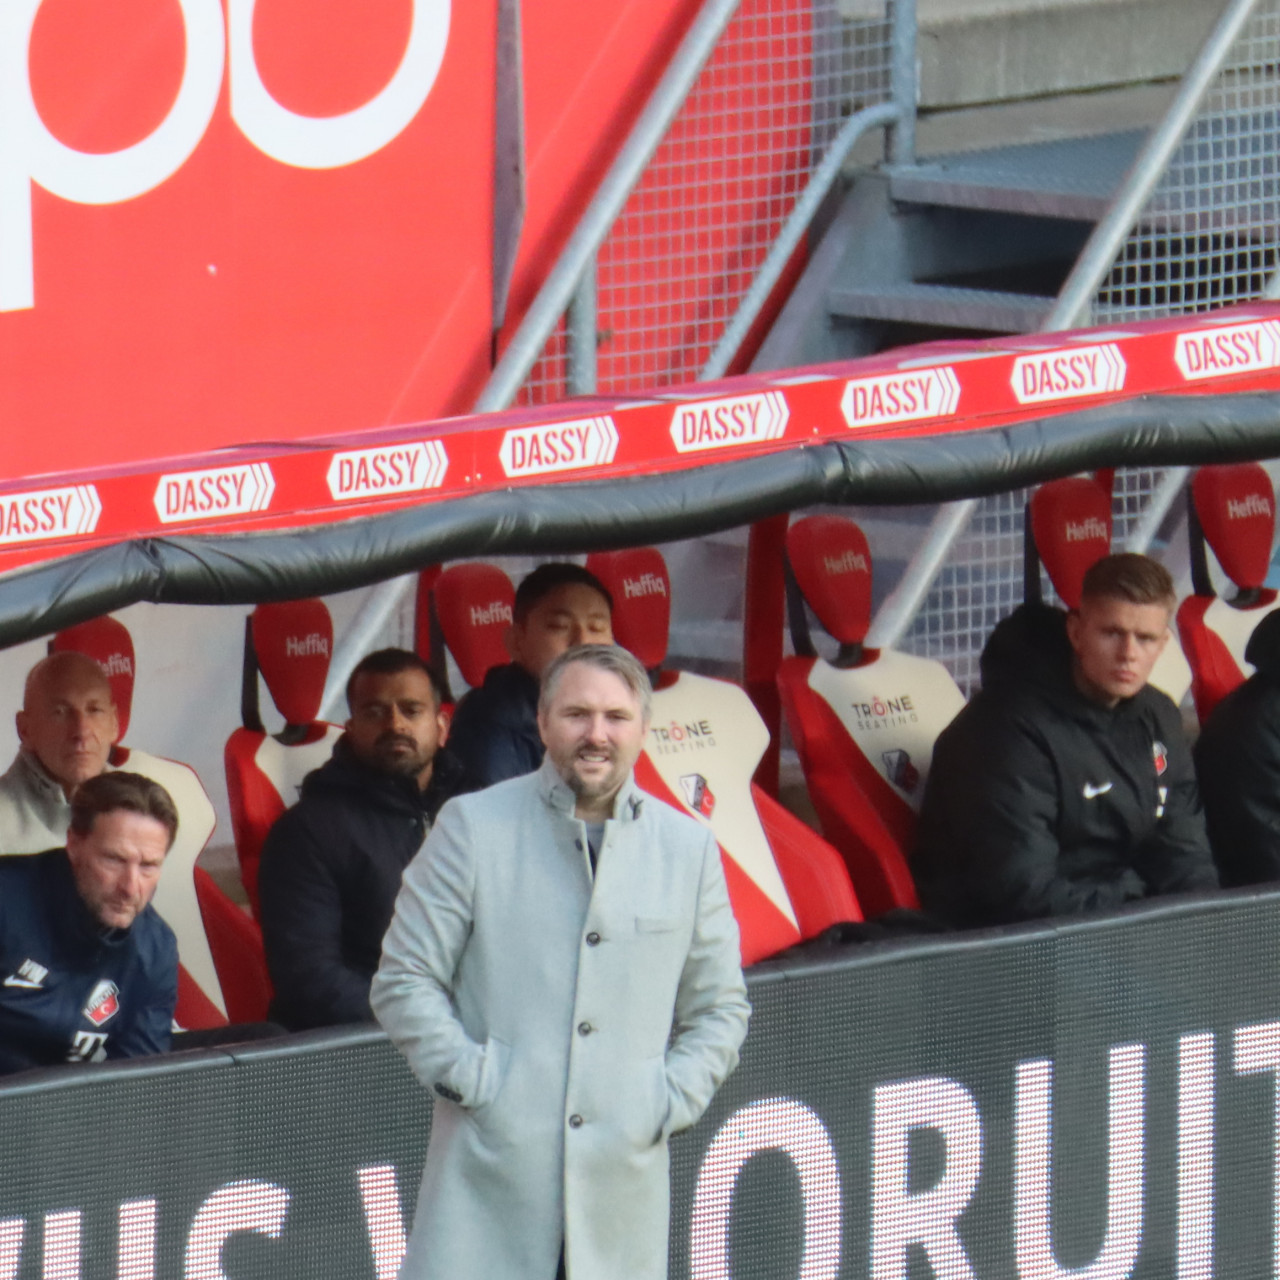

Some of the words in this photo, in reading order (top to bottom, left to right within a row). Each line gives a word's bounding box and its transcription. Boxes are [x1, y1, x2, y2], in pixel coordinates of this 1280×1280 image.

[1185, 329, 1262, 371] DASSY
[1022, 352, 1099, 394] DASSY
[852, 376, 932, 419] DASSY
[681, 400, 762, 444] DASSY
[510, 425, 591, 469] DASSY
[338, 448, 421, 492] DASSY
[166, 471, 247, 515] DASSY
[1065, 517, 1108, 542] Heffiq
[623, 573, 667, 598] Heffiq
[470, 601, 514, 627] Heffiq
[97, 652, 133, 677] effiq
[285, 633, 329, 658] Heffiq
